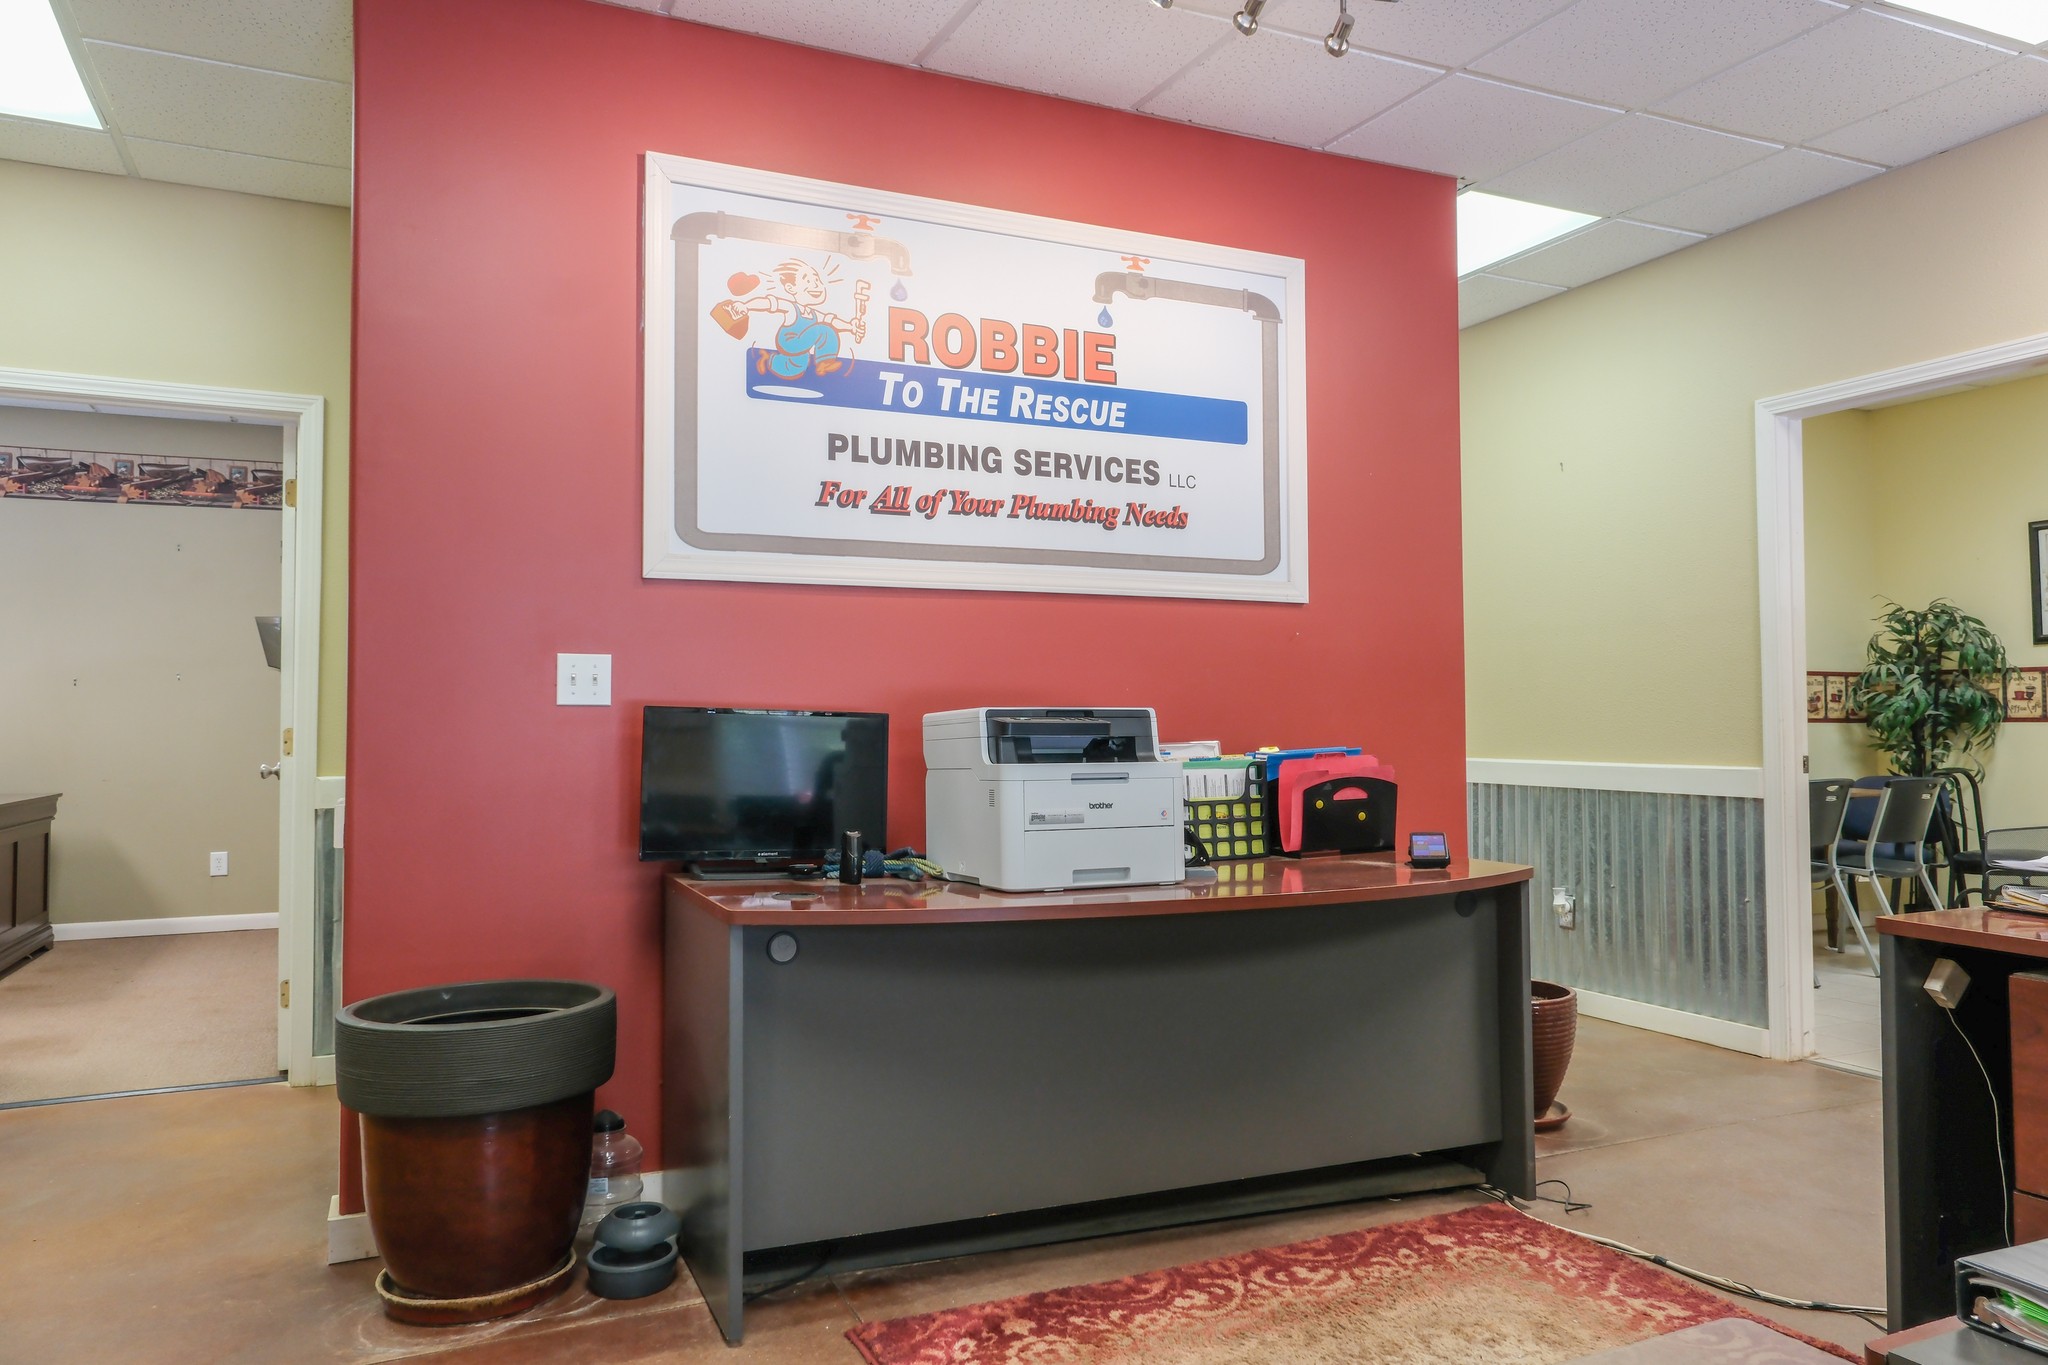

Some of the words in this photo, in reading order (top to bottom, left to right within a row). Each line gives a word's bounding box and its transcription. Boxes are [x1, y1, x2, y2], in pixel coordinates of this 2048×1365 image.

[888, 305, 1118, 386] ROBBIE
[827, 432, 1003, 474] PLUMBING
[1013, 448, 1160, 486] SERVICES
[1168, 473, 1197, 489] LLC
[814, 480, 868, 509] For
[868, 485, 913, 516] All
[915, 488, 948, 520] of
[947, 489, 1006, 518] Your
[1006, 493, 1121, 531] Plumbing
[1122, 501, 1190, 530] Needs
[1088, 802, 1114, 810] brother
